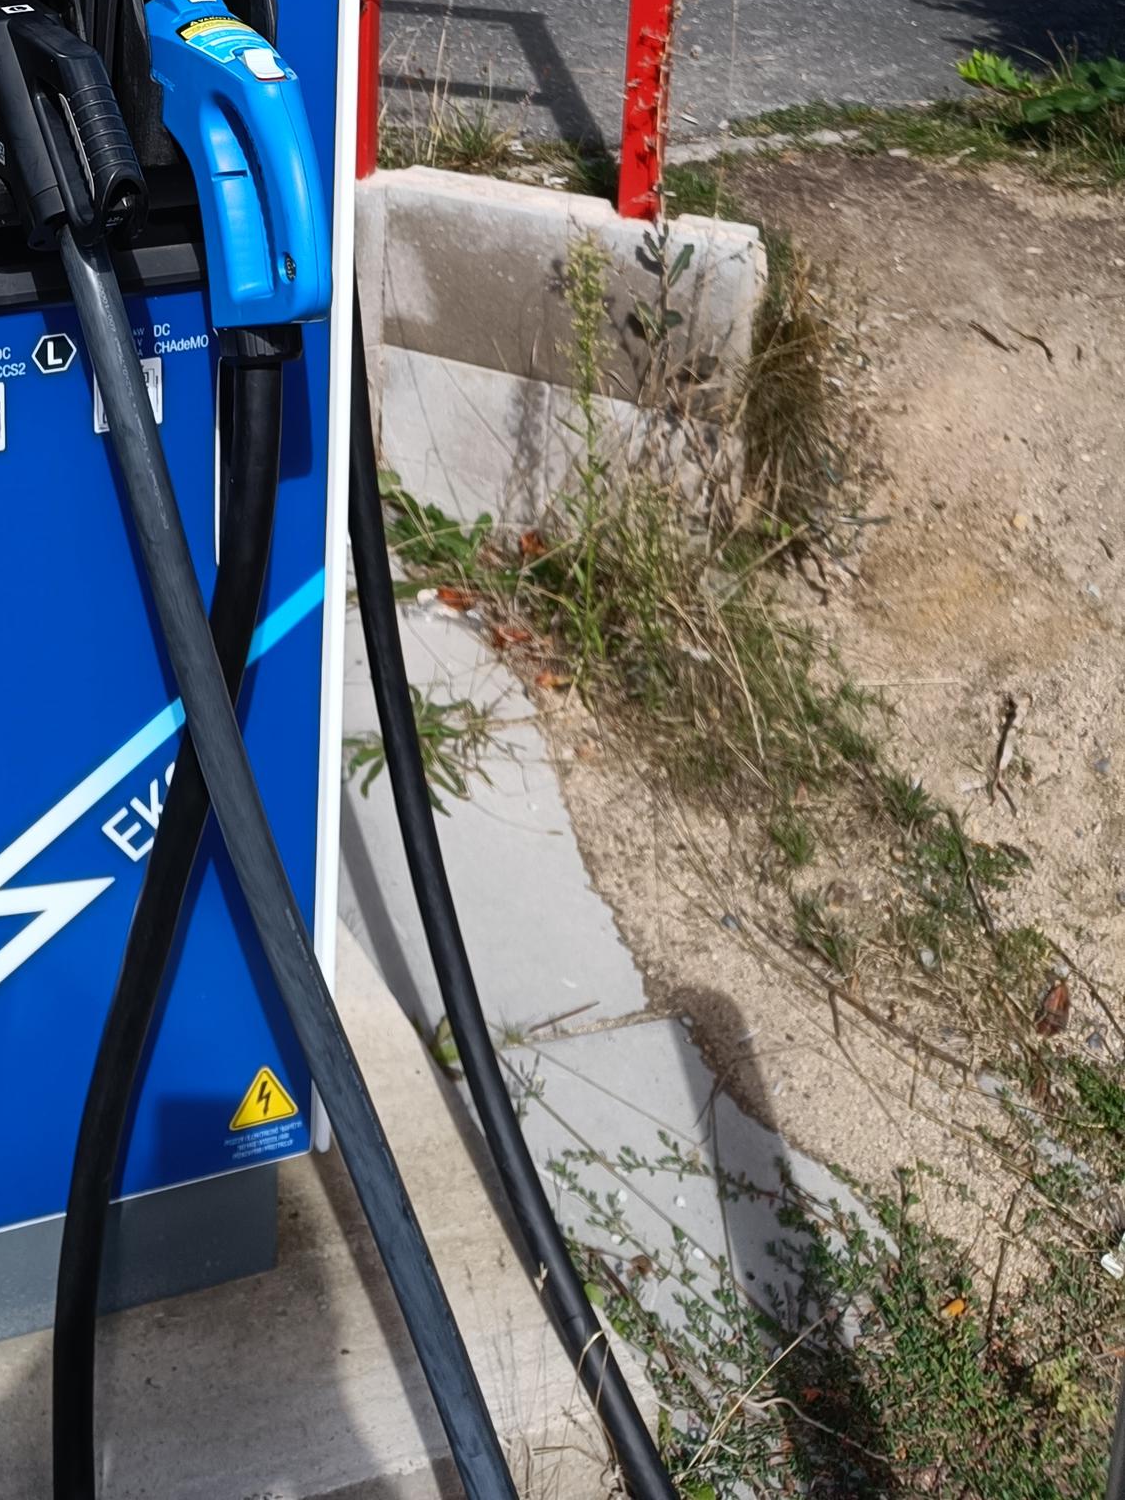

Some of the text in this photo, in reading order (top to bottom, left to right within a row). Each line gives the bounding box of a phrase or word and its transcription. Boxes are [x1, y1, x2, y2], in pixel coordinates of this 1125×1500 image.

[153, 323, 170, 337] DC
[47, 341, 63, 365] L
[154, 335, 209, 354] CHAdeMO
